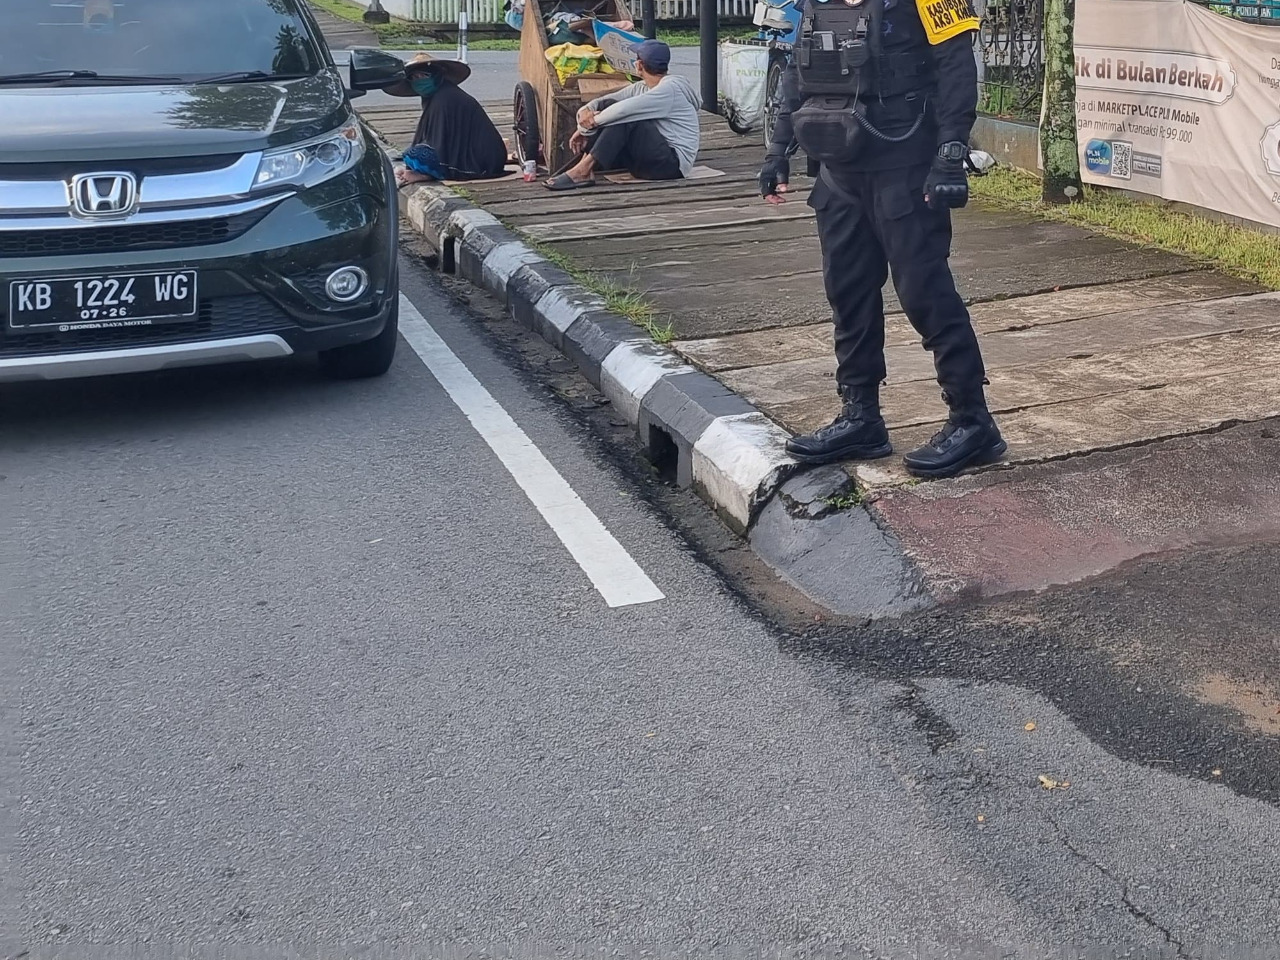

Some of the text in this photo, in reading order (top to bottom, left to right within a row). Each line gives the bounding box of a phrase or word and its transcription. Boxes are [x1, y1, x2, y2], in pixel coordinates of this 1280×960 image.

[932, 8, 955, 29] AKSI
[1096, 58, 1111, 80] di
[1116, 59, 1166, 84] Bulan
[1168, 63, 1224, 93] Berkah
[1088, 100, 1096, 112] di
[1098, 101, 1159, 119] MARKETPLACE
[1171, 109, 1200, 126] Mobile
[1094, 120, 1126, 133] minimal
[1127, 122, 1158, 137] transaksi
[1087, 149, 1100, 157] PLN
[1088, 157, 1110, 166] mobile
[18, 274, 188, 311] KB 1224 WG
